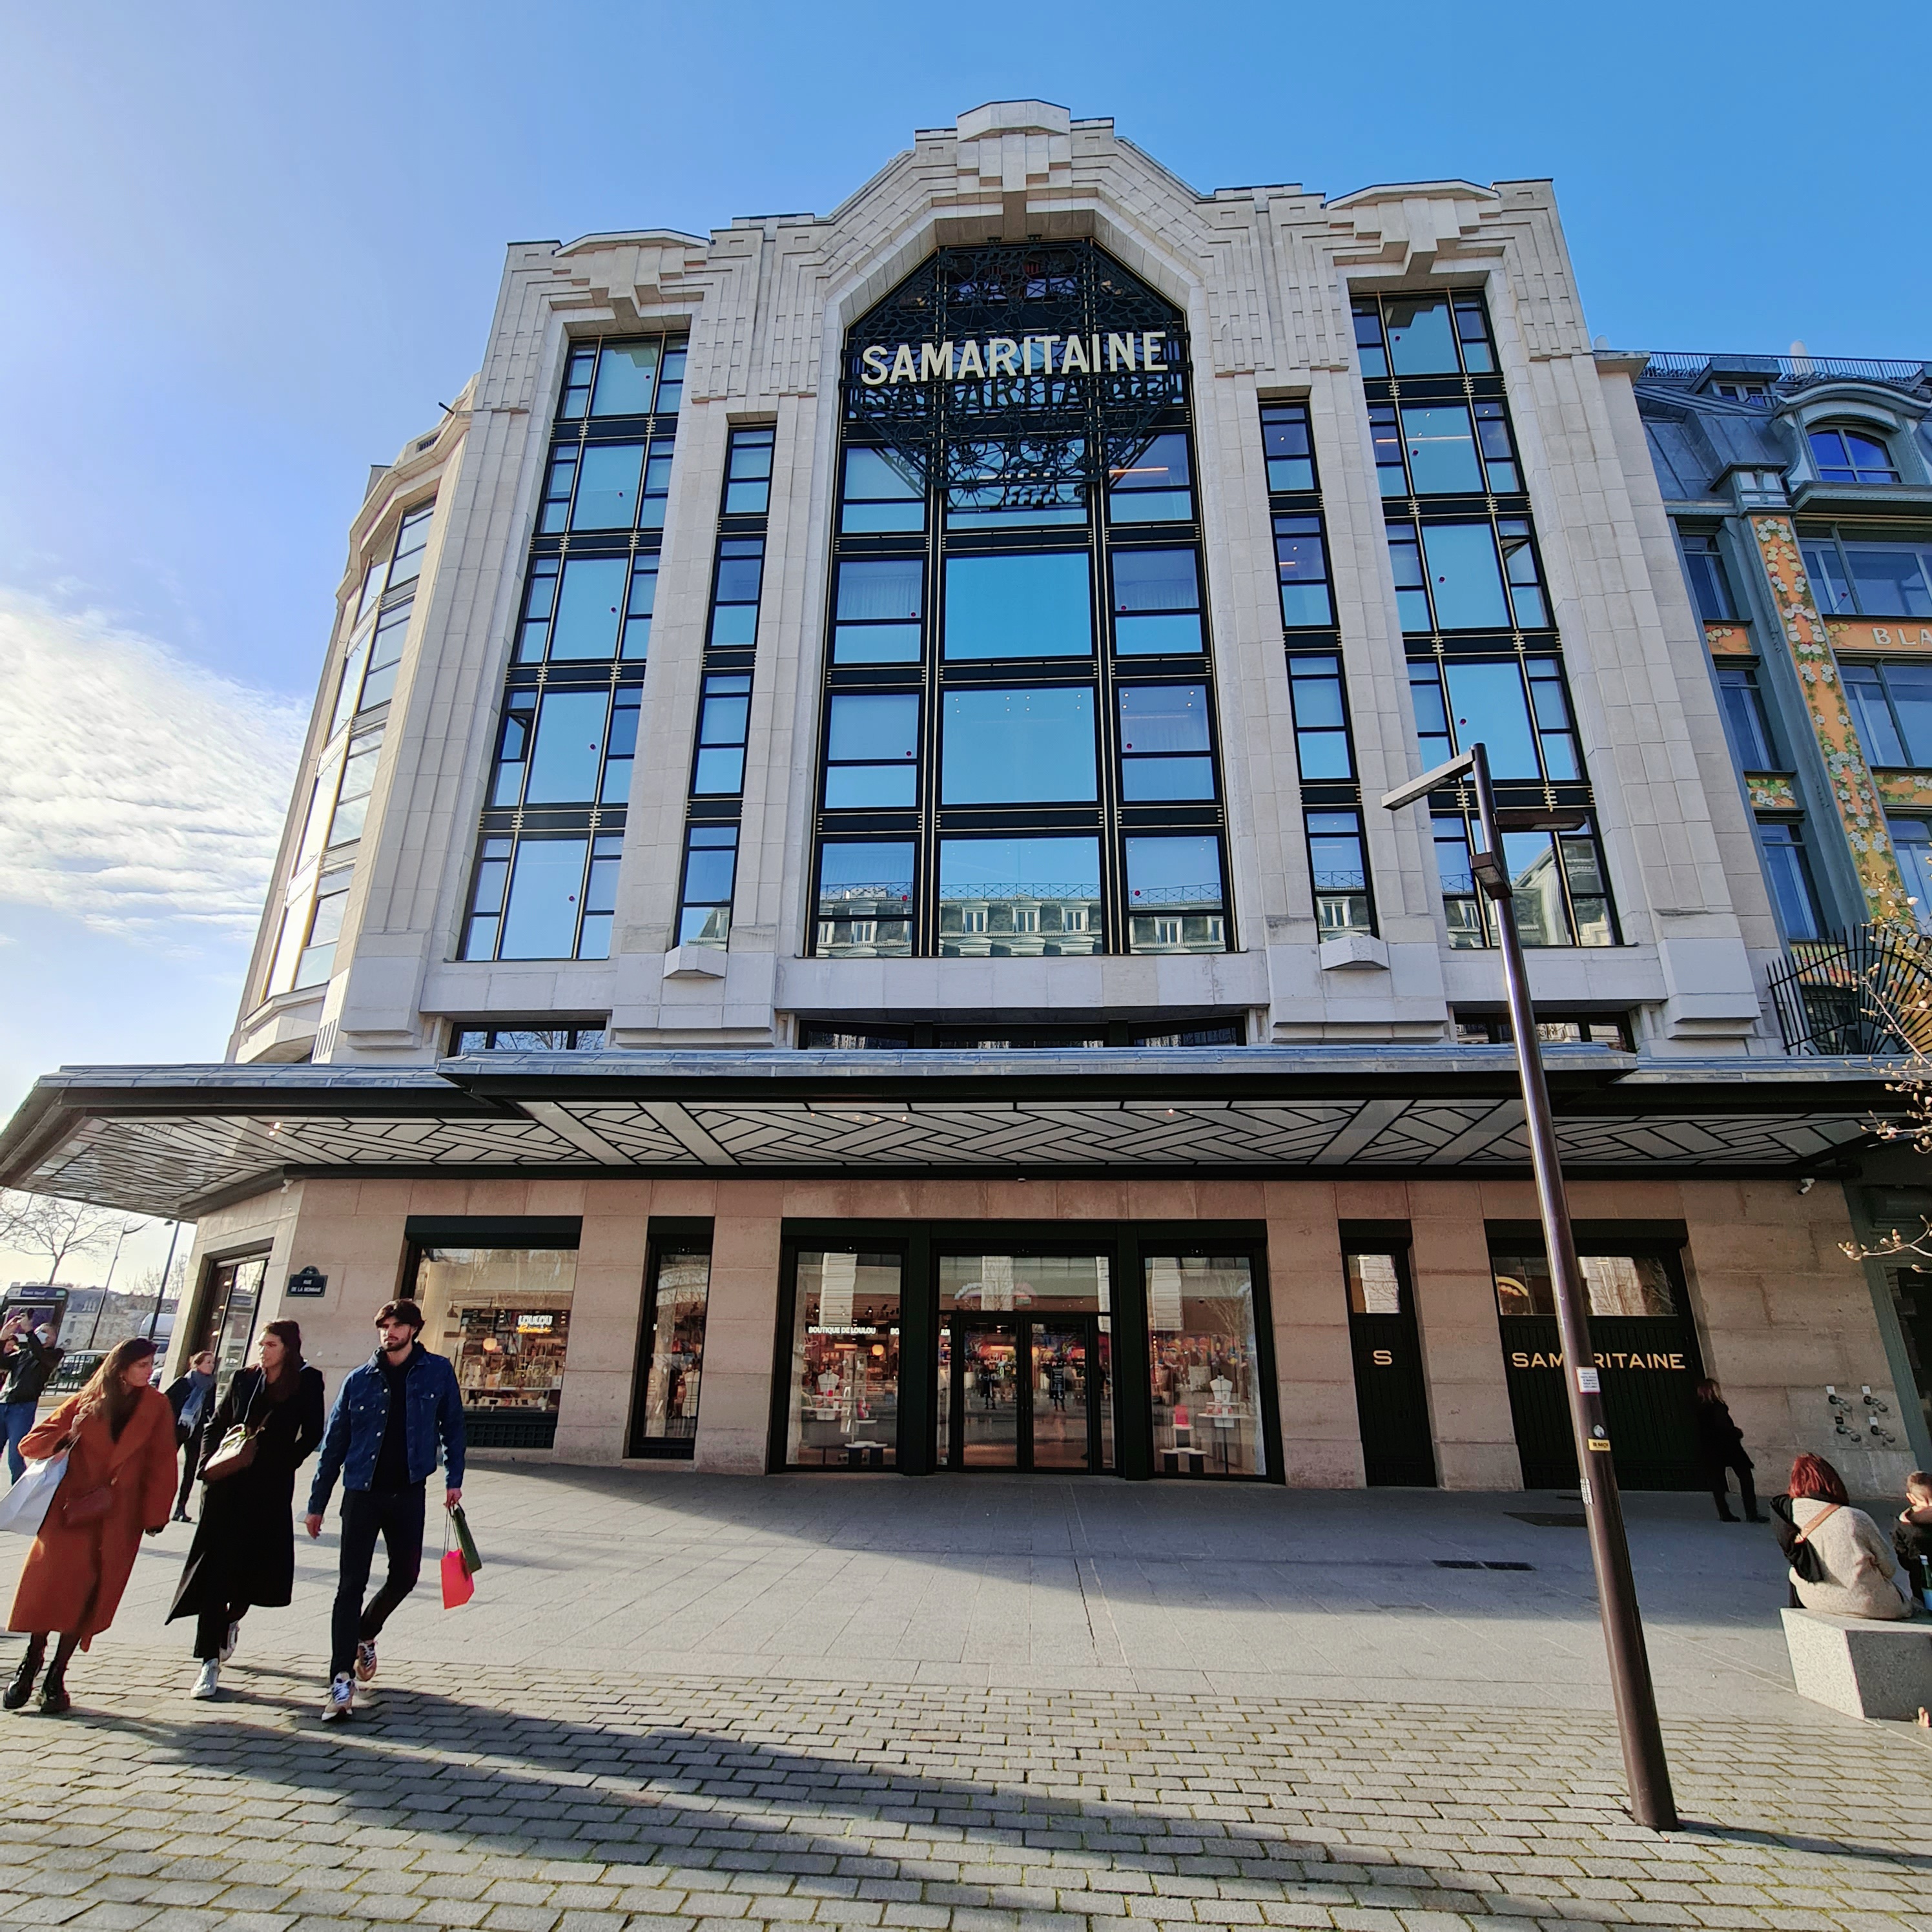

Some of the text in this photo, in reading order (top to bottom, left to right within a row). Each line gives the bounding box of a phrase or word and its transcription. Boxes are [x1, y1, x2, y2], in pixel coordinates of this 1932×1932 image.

[860, 331, 1169, 386] SAMARITAINE
[1872, 627, 1932, 645] BLA
[517, 1315, 553, 1326] LOULOU
[808, 1326, 841, 1335] BOUTIQUE
[850, 1326, 876, 1335] LOULOU
[1373, 1350, 1393, 1365] S
[1512, 1352, 1686, 1369] SAMRITAINE
